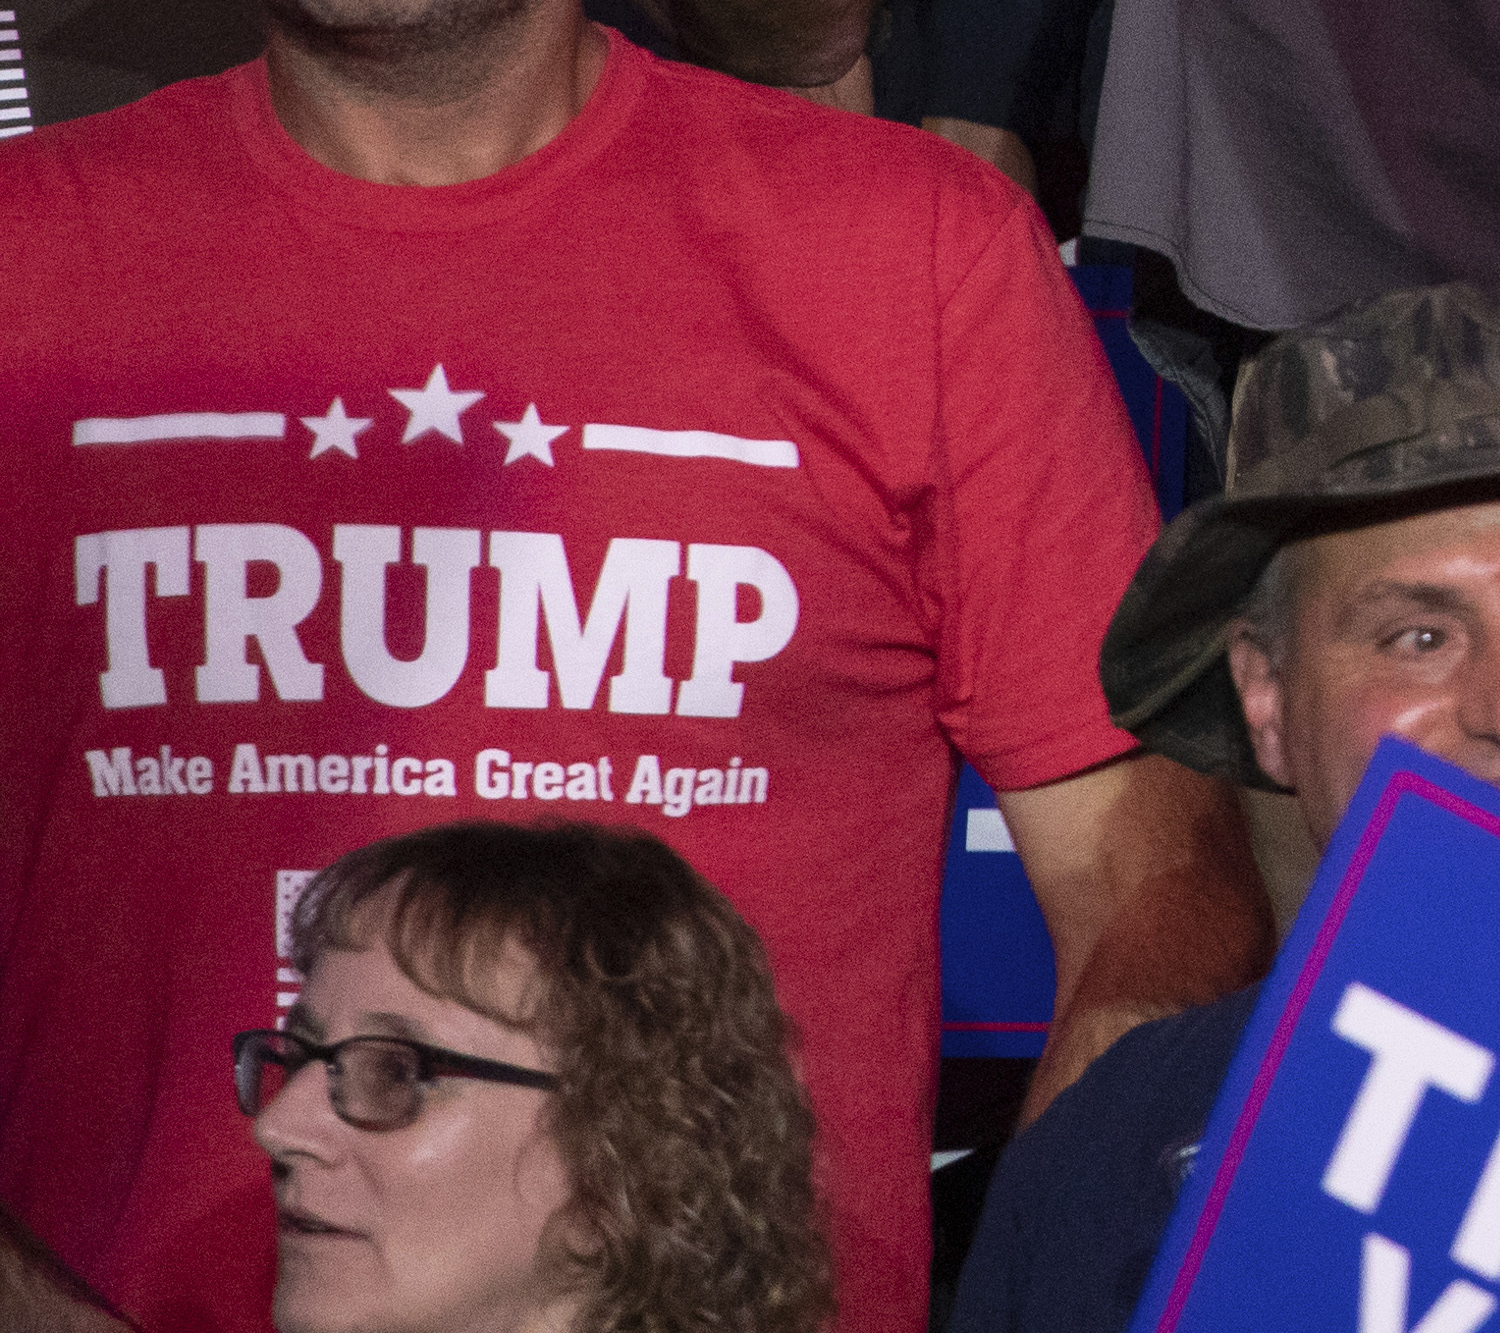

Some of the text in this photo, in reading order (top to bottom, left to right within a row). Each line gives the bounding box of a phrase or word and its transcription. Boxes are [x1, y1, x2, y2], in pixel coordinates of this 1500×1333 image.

[73, 522, 800, 719] TRUMP
[86, 743, 769, 817] Make America Great Again
